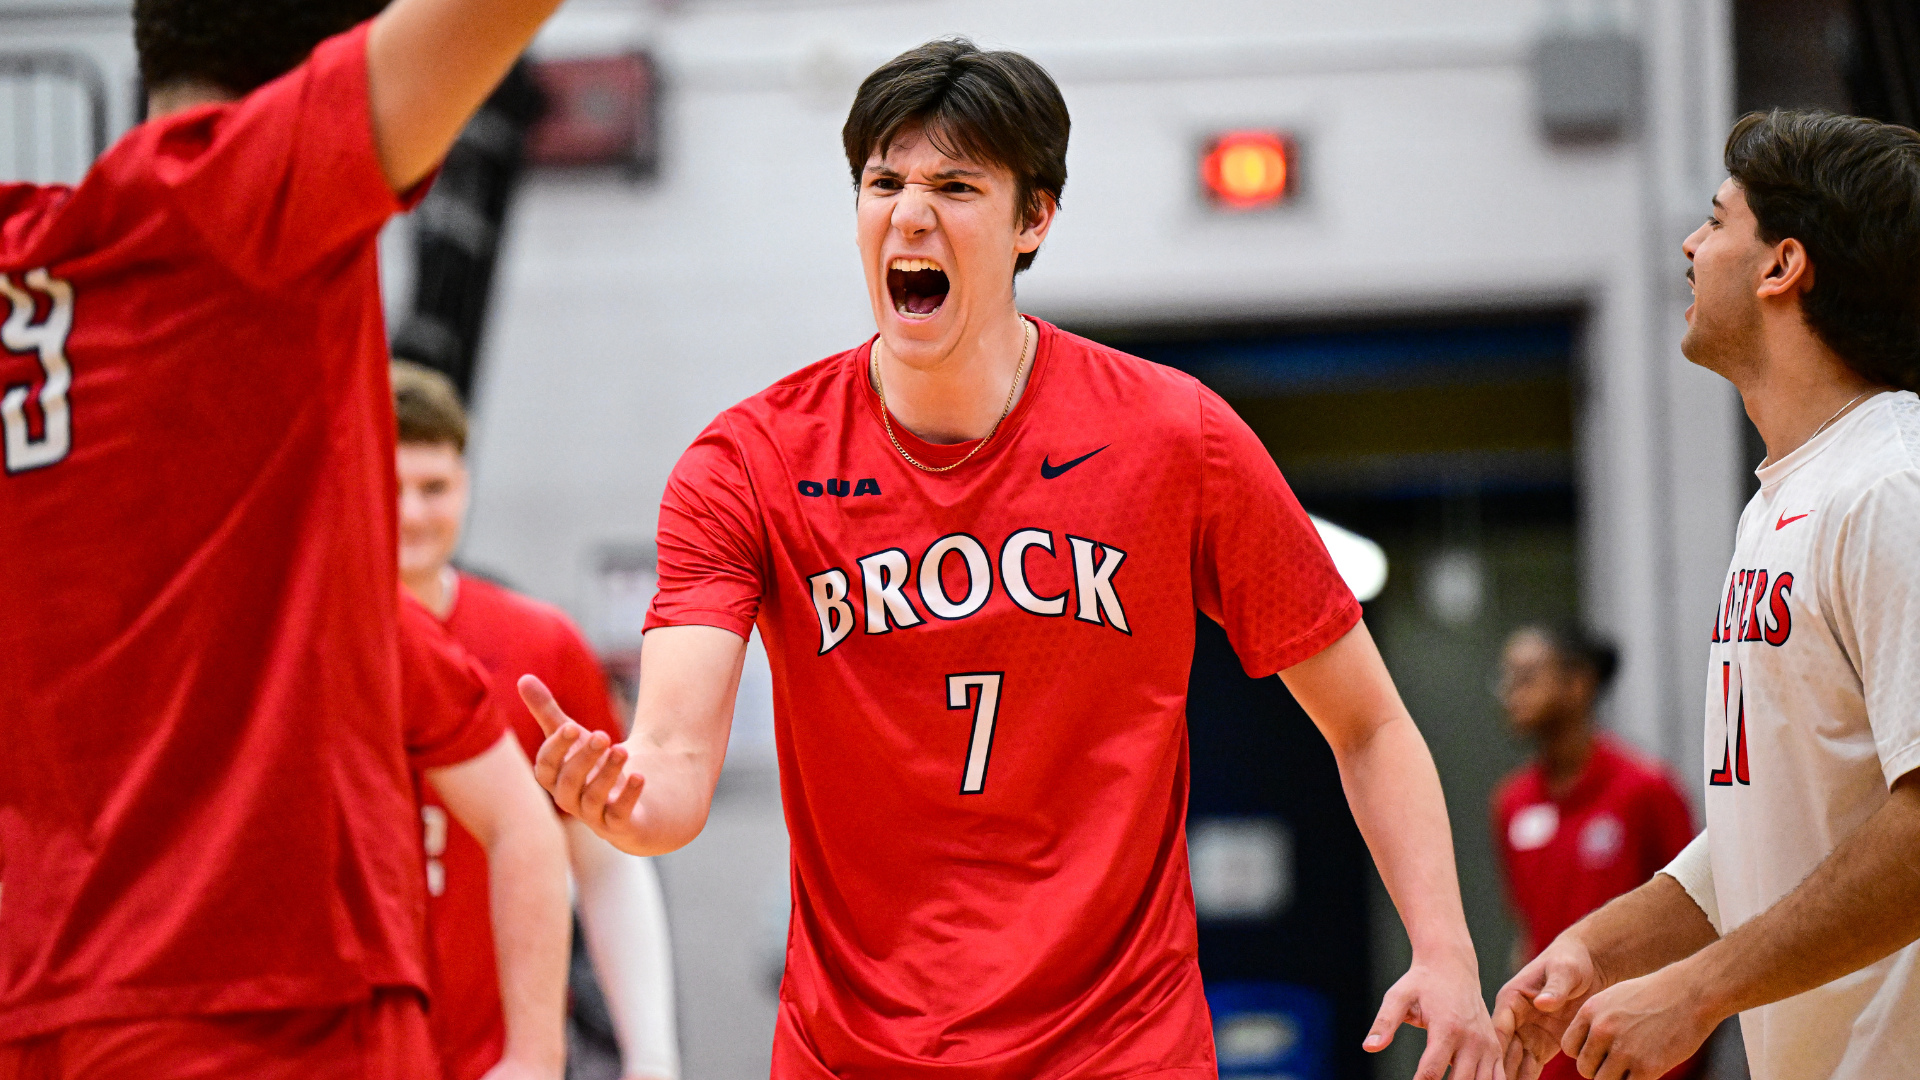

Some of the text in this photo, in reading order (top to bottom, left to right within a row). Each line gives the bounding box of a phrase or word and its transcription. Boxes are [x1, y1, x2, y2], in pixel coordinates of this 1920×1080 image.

[797, 477, 882, 498] OUA
[807, 527, 1133, 656] BROCK
[945, 671, 1005, 795] 7
